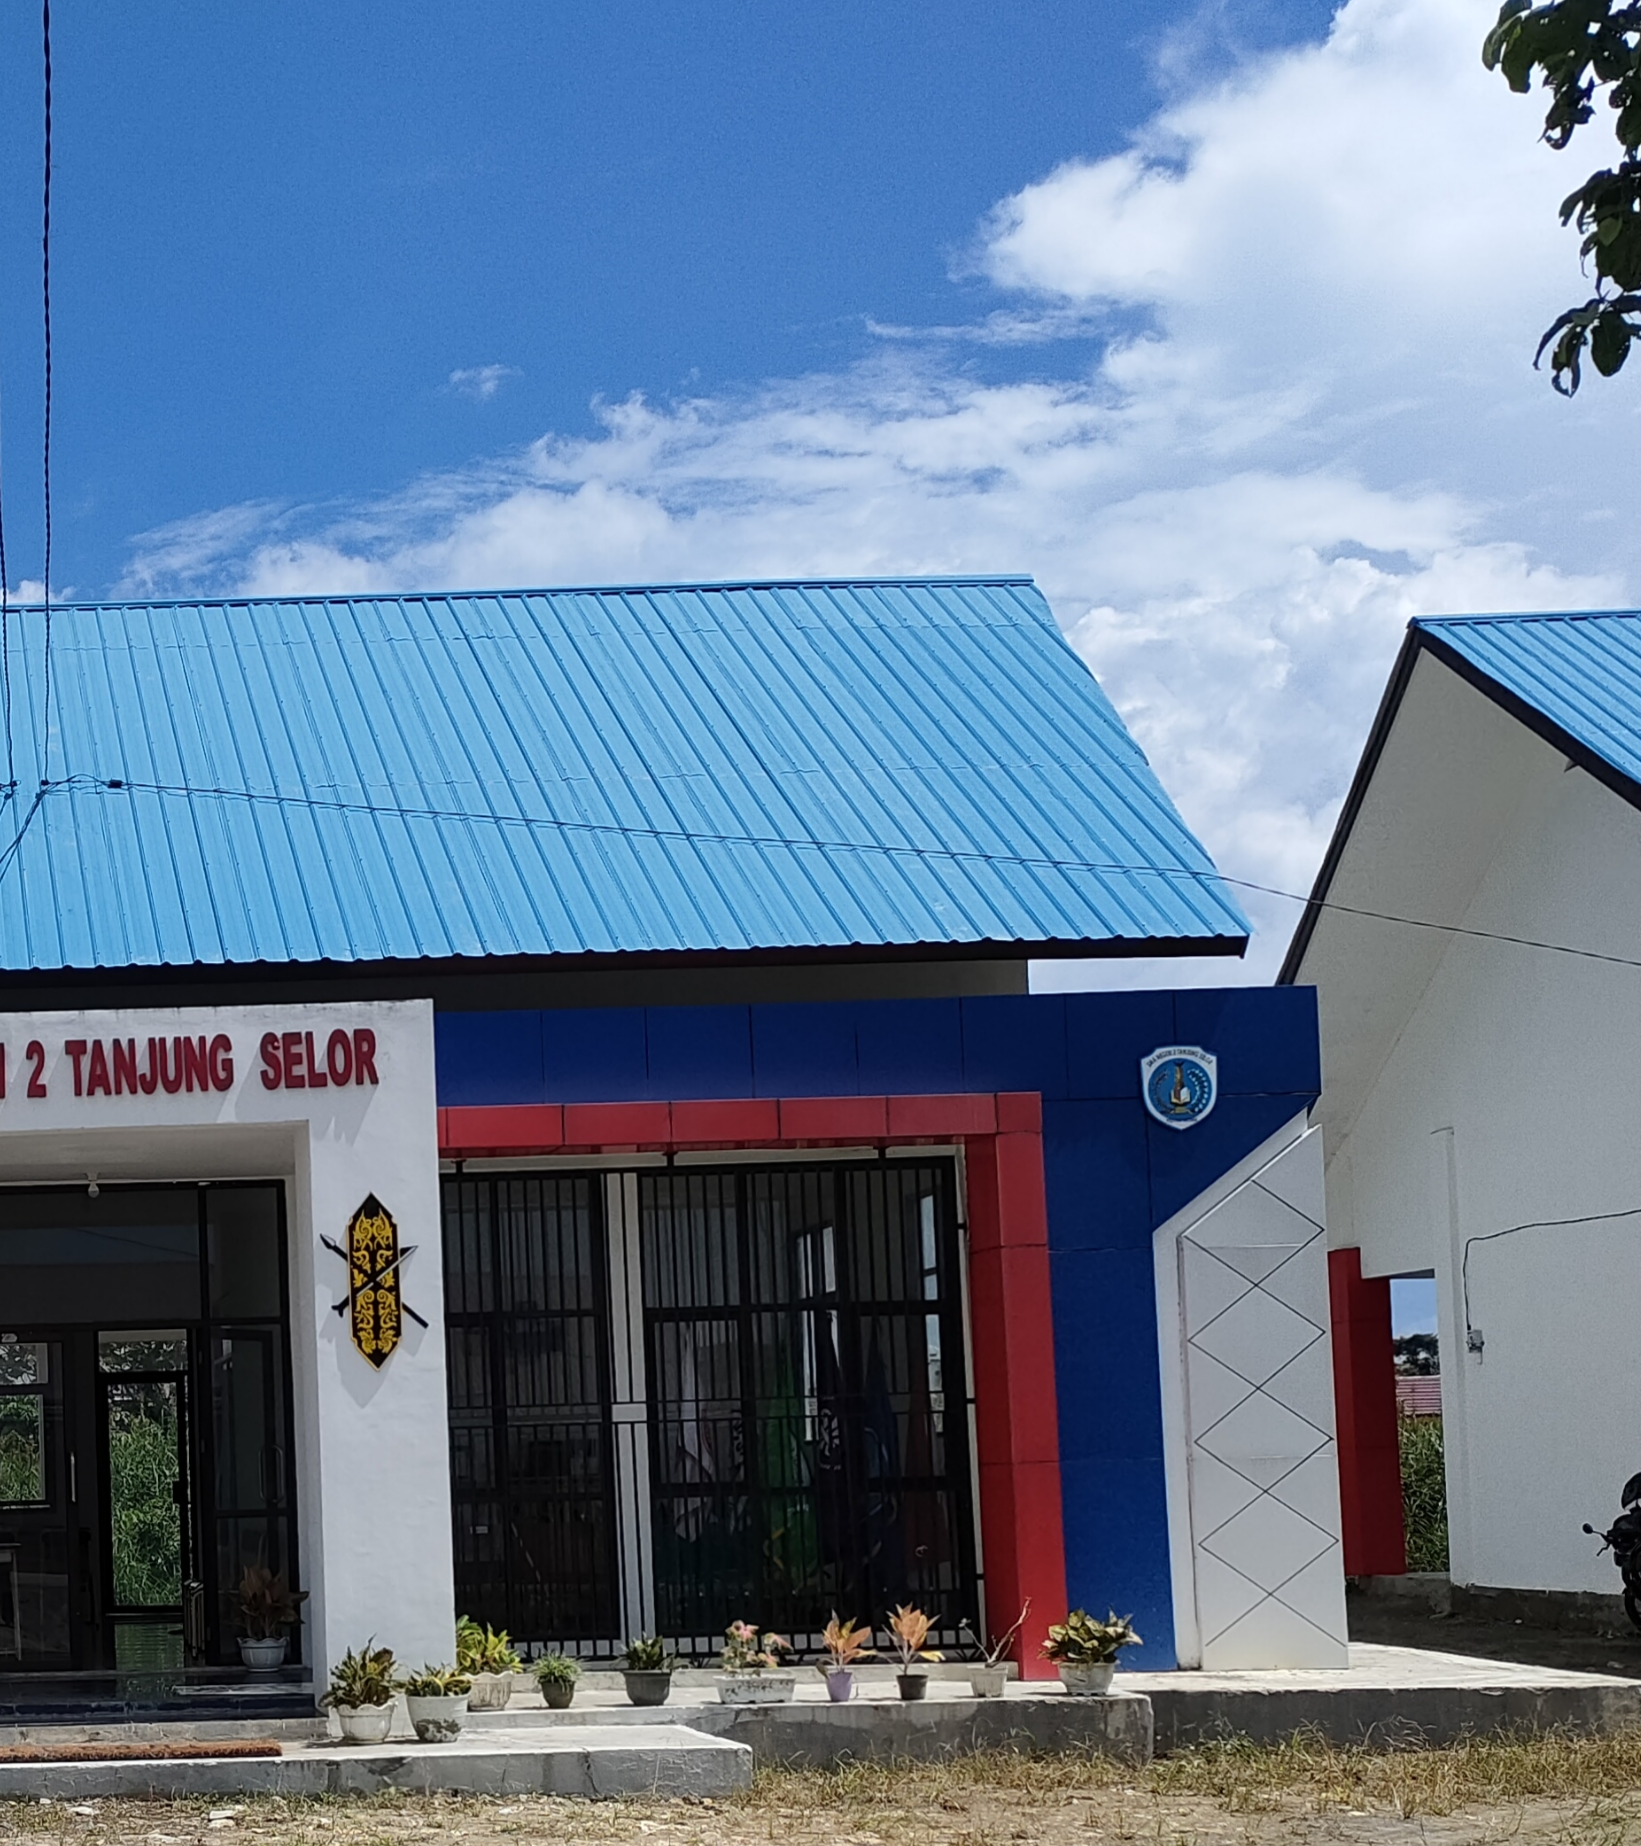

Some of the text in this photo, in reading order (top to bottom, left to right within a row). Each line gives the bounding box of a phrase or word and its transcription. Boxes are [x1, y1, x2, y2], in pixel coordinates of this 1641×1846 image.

[26, 1040, 48, 1098] 2
[65, 1034, 234, 1097] TANJUNG
[260, 1028, 379, 1090] SELOR
